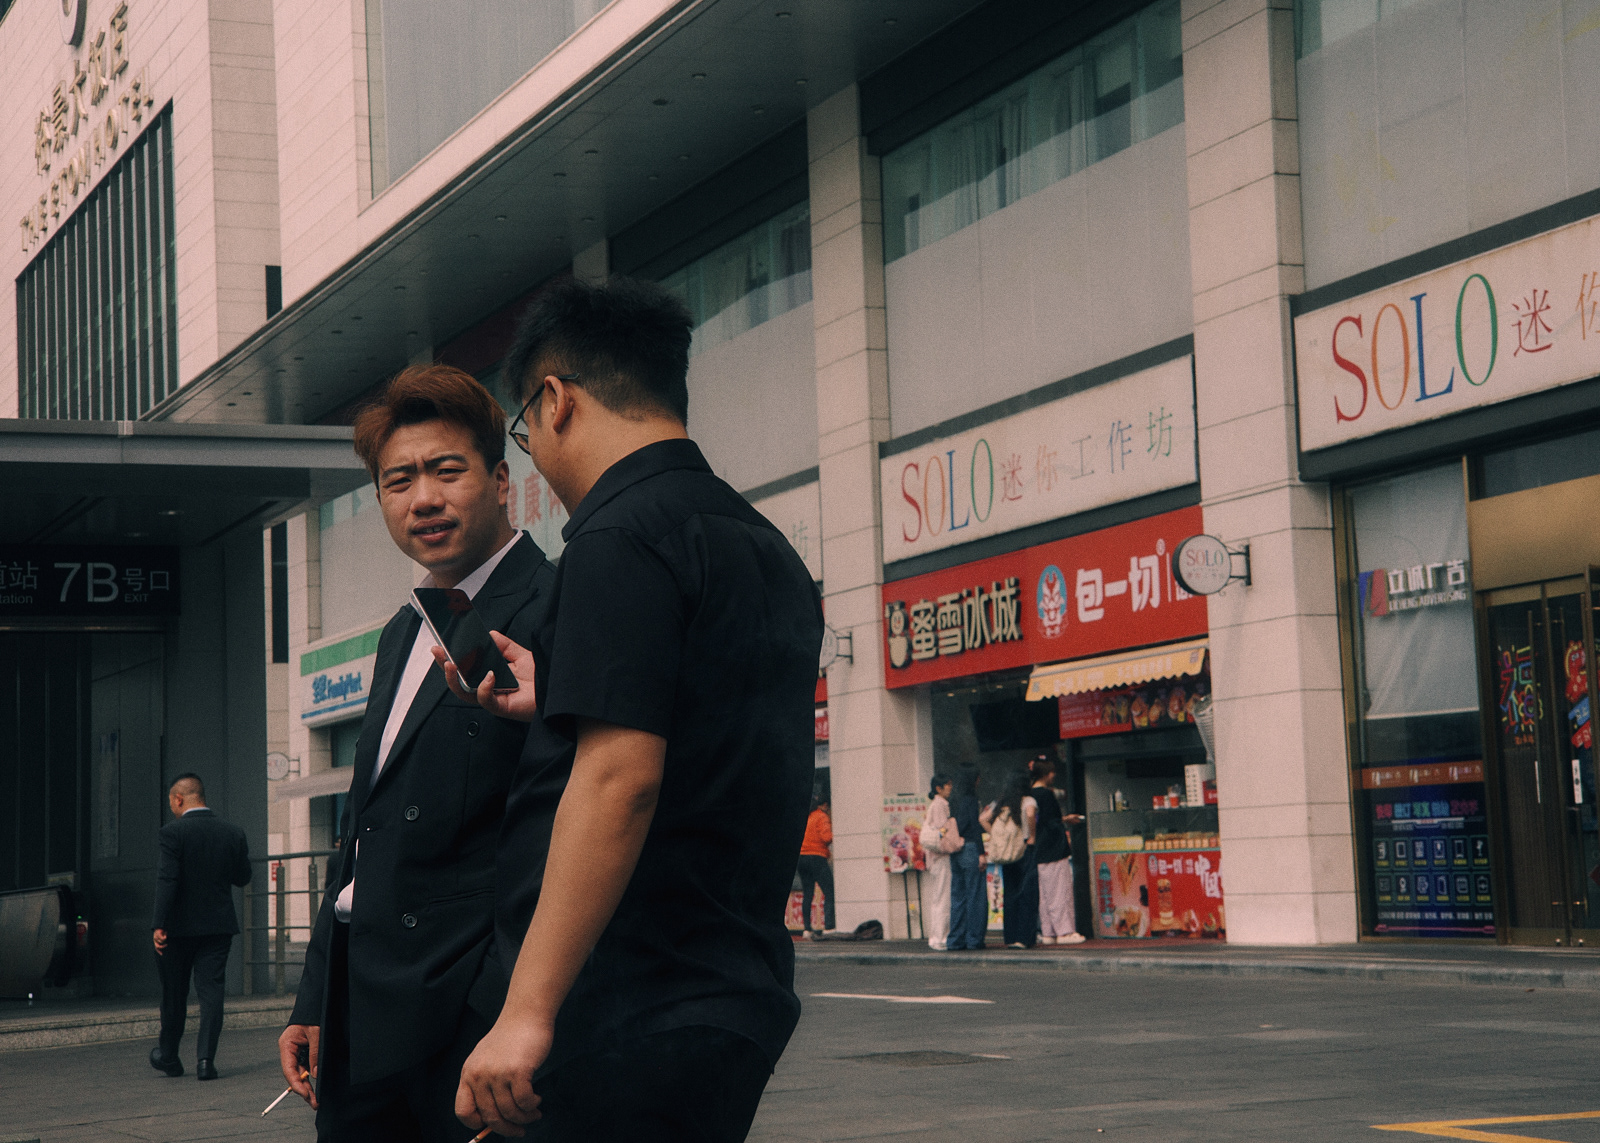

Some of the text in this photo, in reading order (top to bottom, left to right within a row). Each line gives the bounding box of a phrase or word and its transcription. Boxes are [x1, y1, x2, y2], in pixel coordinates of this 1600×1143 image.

[20, 66, 153, 252] THE ETON HOTEL
[1332, 273, 1498, 424] SOLO
[901, 406, 1173, 542] SOLO 迷你工作坊
[0, 561, 170, 602] 站 7B 号口
[1075, 554, 1160, 623] 包一切
[1186, 549, 1224, 567] SOLO
[124, 593, 149, 603] EXIT
[911, 577, 1023, 661] 蜜雪冰城
